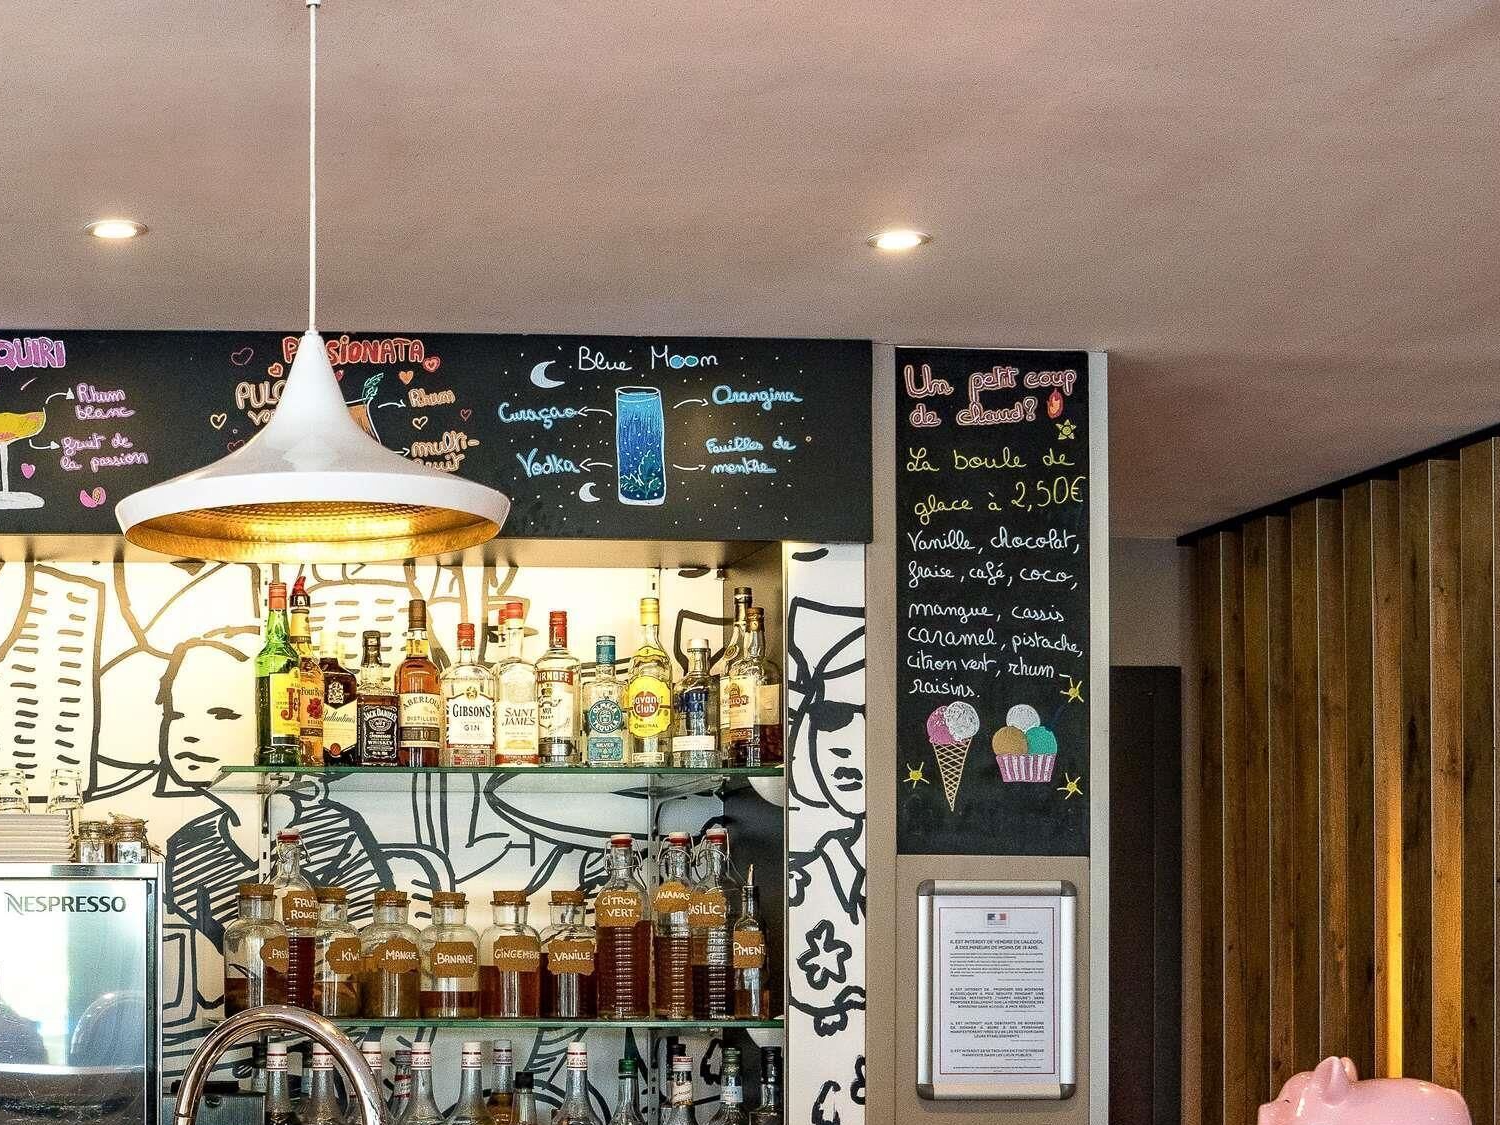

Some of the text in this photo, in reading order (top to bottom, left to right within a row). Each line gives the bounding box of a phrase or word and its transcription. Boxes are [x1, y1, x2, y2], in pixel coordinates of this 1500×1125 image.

[282, 335, 425, 364] PSIONATA
[578, 345, 719, 371] Blue Moon
[904, 364, 1077, 403] Un petit coup
[76, 383, 126, 404] Rhum
[408, 387, 456, 408] Rhum
[711, 385, 803, 411] Orangina
[75, 404, 136, 421] blanc
[498, 402, 576, 429] Curaçao
[909, 403, 941, 427] de
[61, 433, 134, 456] fruit de
[772, 436, 796, 450] de
[60, 452, 149, 472] la passion
[516, 448, 580, 478] Vodka
[711, 457, 777, 474] menthe
[907, 447, 1075, 471] La boule de
[915, 477, 1086, 525] glace à 2,50€
[991, 527, 1080, 553] chocolat,
[1011, 604, 1064, 622] cassis
[907, 650, 957, 671] citron
[536, 671, 570, 683] IRNOFF
[364, 710, 377, 721] JACK
[505, 708, 535, 717] SAINT
[592, 701, 618, 714] OLMECA
[636, 703, 655, 714] Club
[502, 717, 535, 727] JAMES
[592, 720, 620, 733] TEQUILA
[6, 892, 126, 915] NESPRESSO
[293, 896, 317, 907] FRUI
[656, 890, 691, 902] ANANAS
[607, 908, 634, 917] VERT
[272, 949, 289, 958] PASS
[385, 950, 417, 960] MANGUE
[495, 948, 540, 960] GINGEMBR
[733, 941, 766, 956] PIMENT
[437, 954, 474, 964] BANANE
